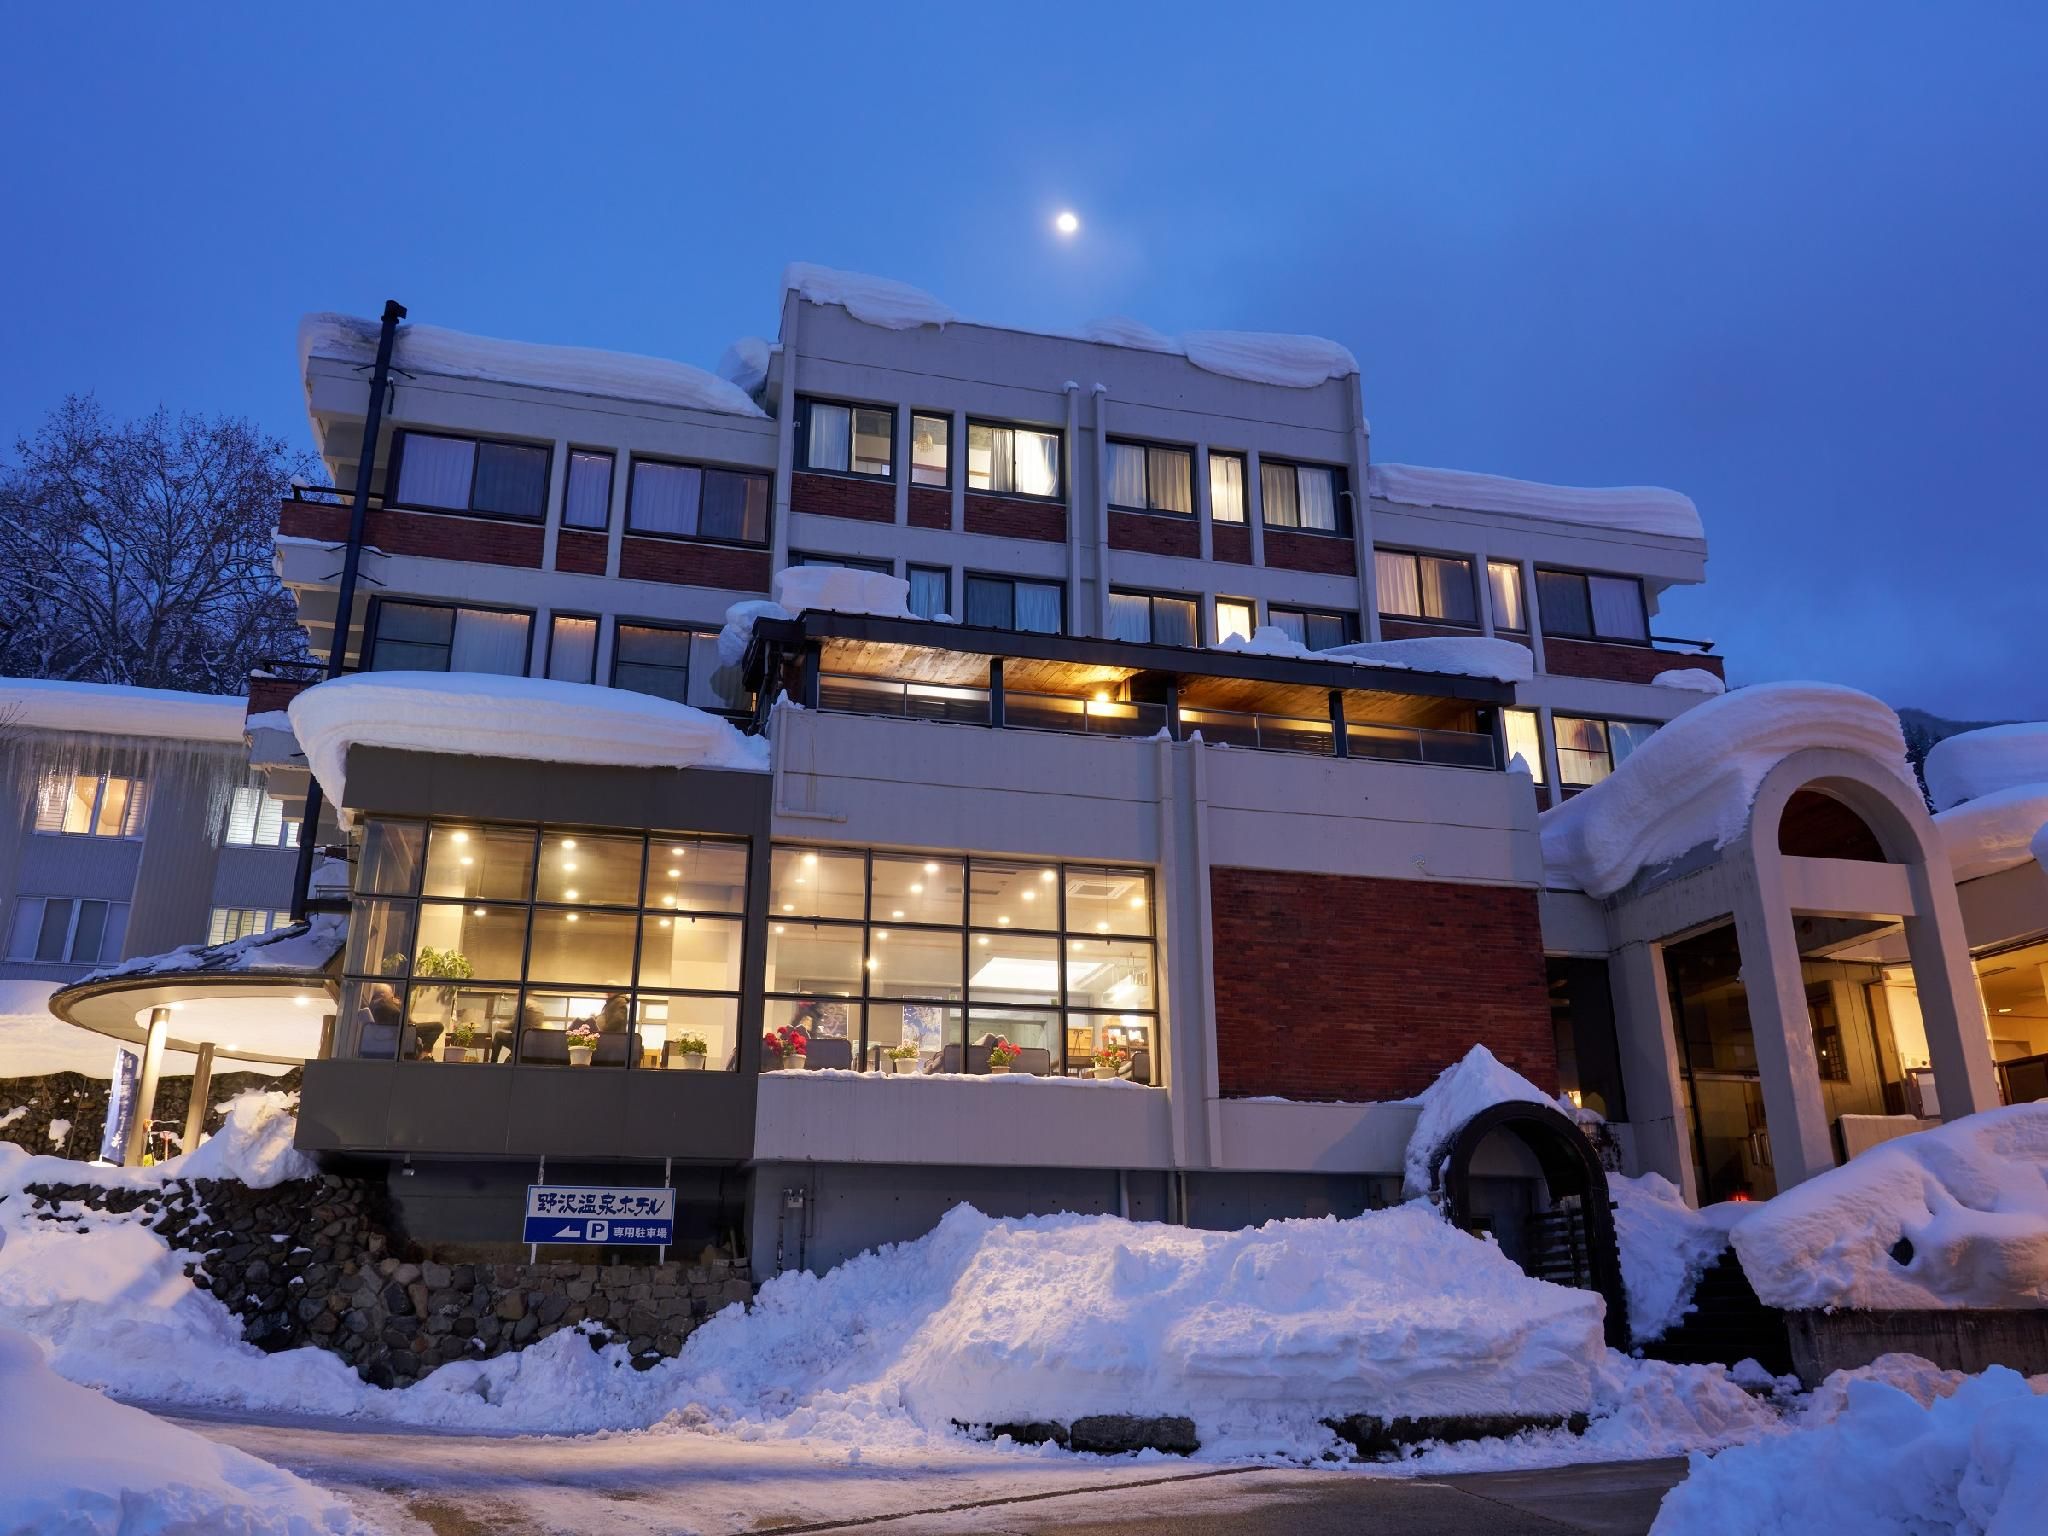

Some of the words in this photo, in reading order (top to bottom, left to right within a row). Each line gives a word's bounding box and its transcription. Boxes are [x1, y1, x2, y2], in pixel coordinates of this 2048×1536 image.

[537, 1191, 666, 1217] 野沢温泉ホテル
[590, 1223, 605, 1239] P
[613, 1227, 667, 1239] 専用駐車場
